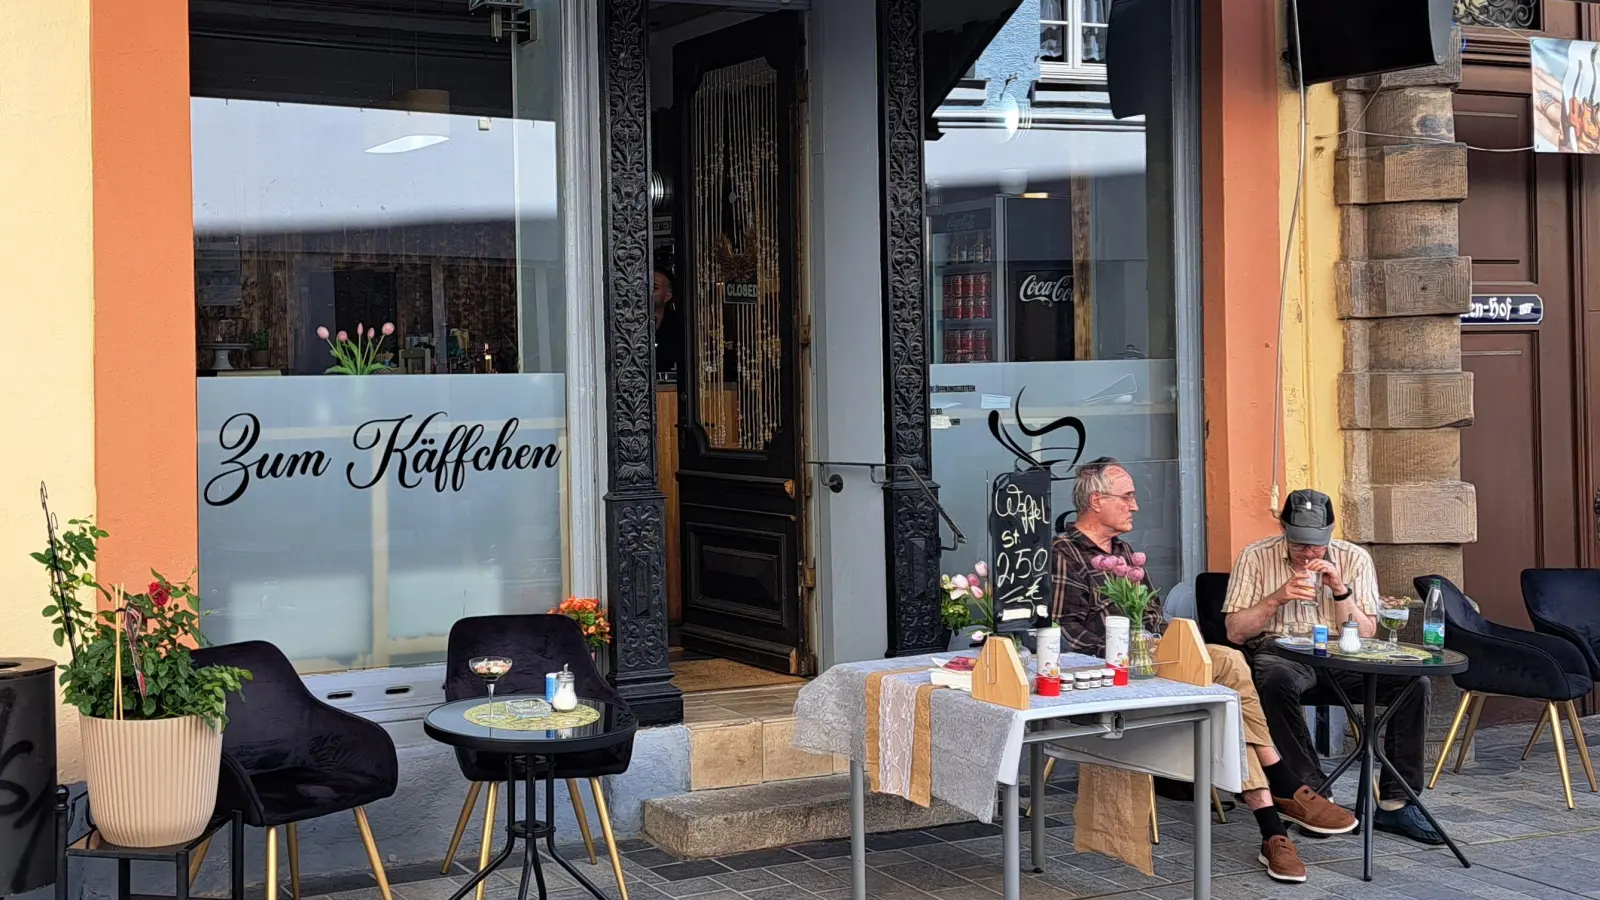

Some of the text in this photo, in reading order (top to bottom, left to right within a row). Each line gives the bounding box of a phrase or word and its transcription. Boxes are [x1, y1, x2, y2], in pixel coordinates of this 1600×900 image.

[726, 283, 757, 297] CLOSED
[1460, 297, 1512, 320] en-Hof
[204, 411, 561, 506] Zum Käffchen
[995, 484, 1050, 534] Waffel
[997, 548, 1048, 587] 2,50
